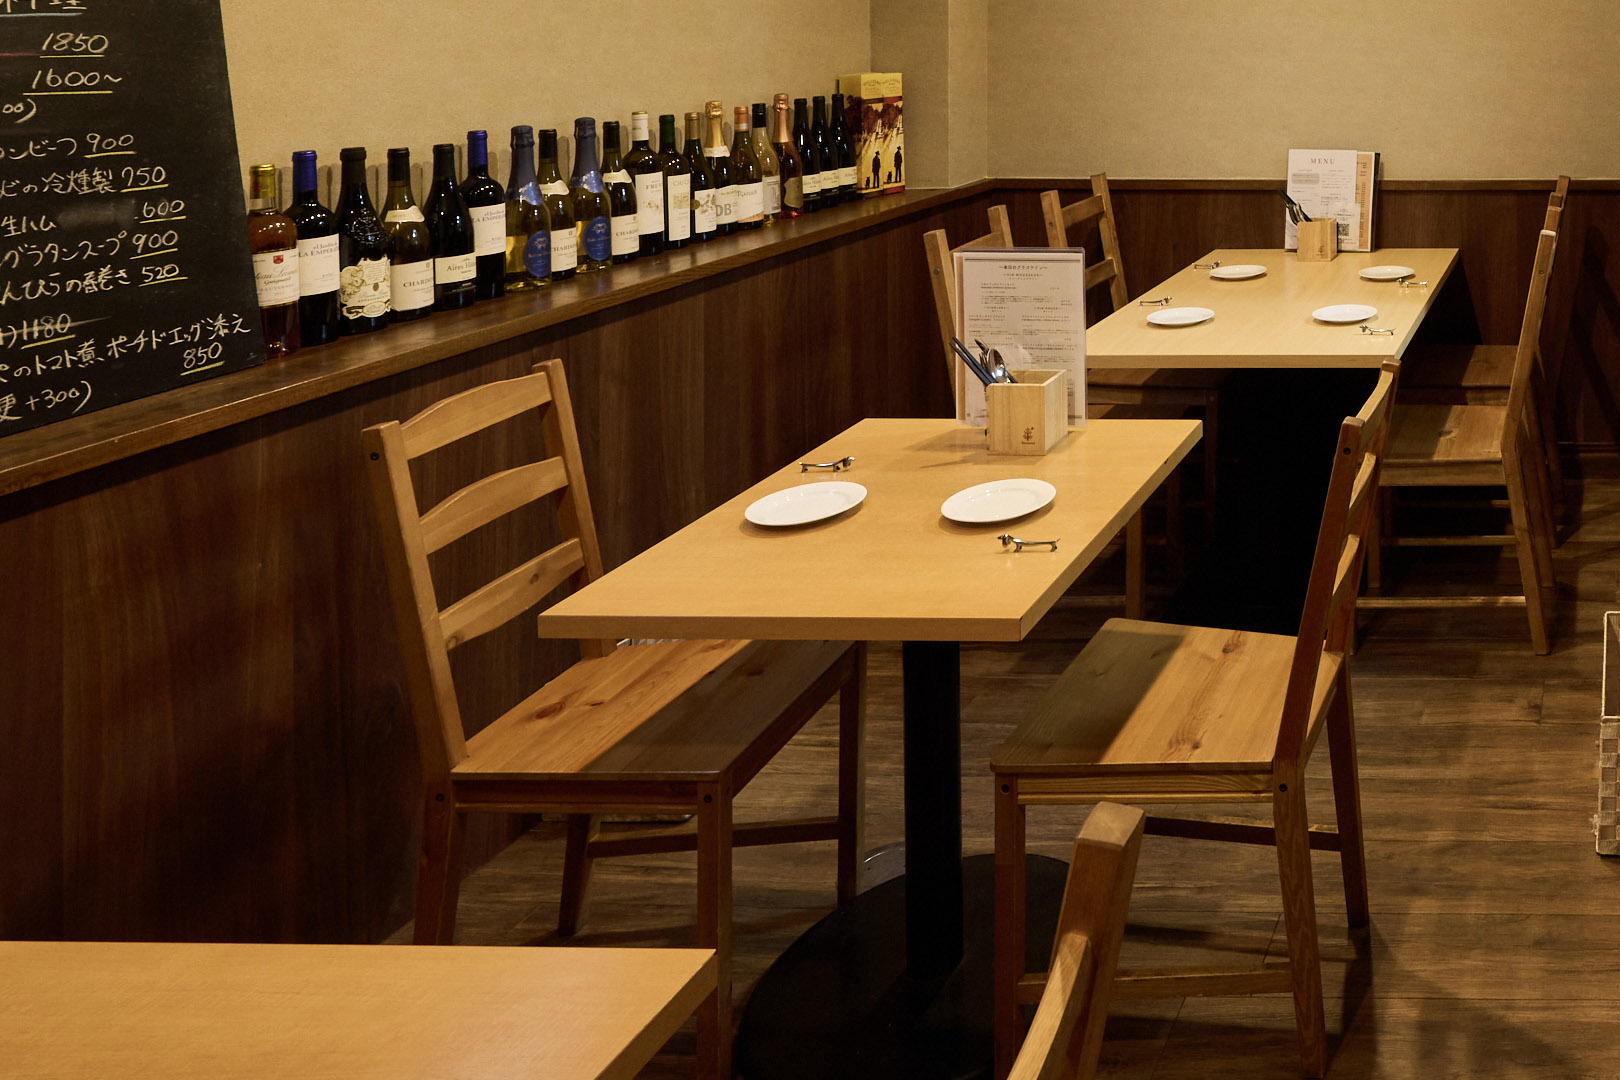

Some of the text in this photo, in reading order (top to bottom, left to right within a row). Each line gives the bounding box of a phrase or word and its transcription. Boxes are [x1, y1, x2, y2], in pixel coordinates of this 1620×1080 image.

[42, 32, 108, 54] 1850
[87, 133, 134, 152] 900
[1310, 157, 1336, 165] MENU
[121, 166, 166, 187] 750
[143, 200, 185, 218] 600
[1, 215, 57, 238] 生ハム
[132, 230, 178, 254] 900
[142, 264, 179, 283] 520
[183, 342, 223, 369] 850
